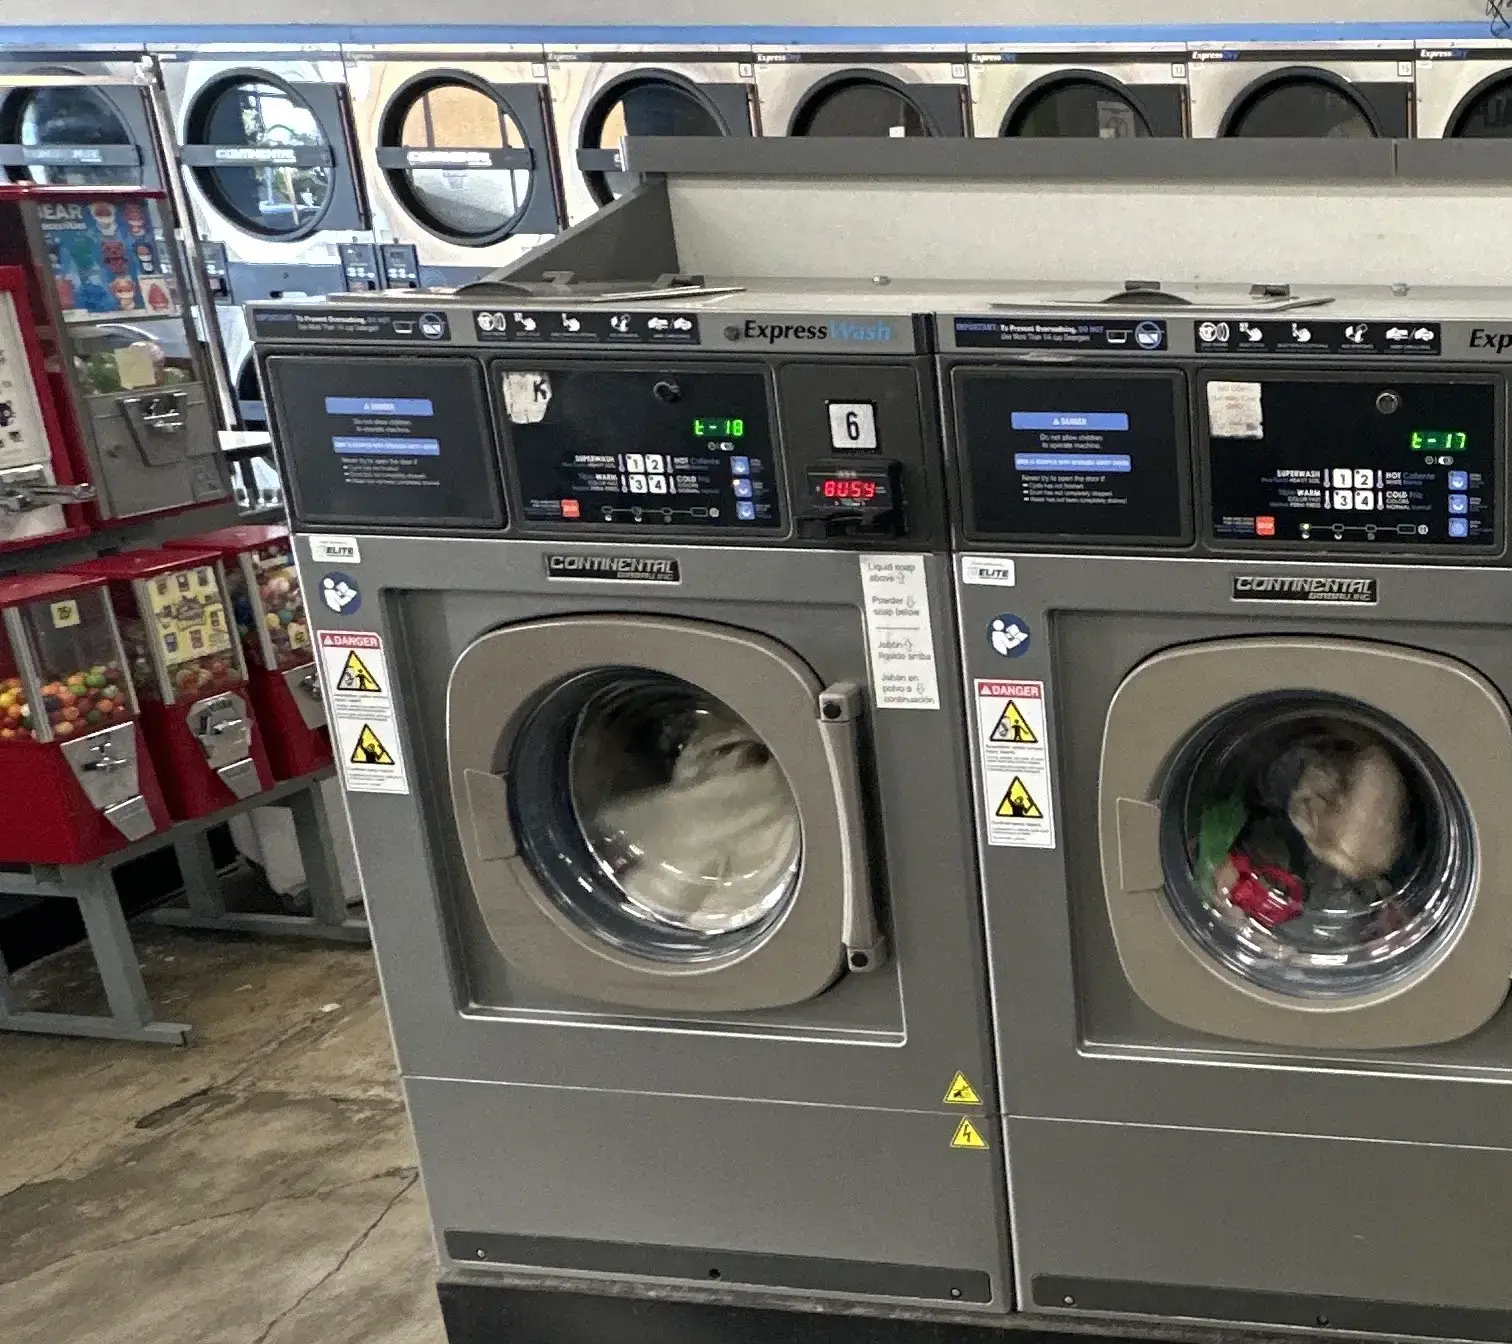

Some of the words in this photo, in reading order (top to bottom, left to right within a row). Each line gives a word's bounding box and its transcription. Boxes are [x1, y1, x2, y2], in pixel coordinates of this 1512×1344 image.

[743, 319, 893, 344] ExpressWash
[846, 411, 860, 441] 6
[823, 480, 875, 498] BUSY
[326, 546, 354, 555] ELITE
[550, 556, 675, 573] CONTINENTAL
[978, 568, 1009, 578] ELITE
[1236, 577, 1373, 594] CONTINENTAL
[332, 635, 378, 647] DANGER
[991, 685, 1039, 697] DANGER
